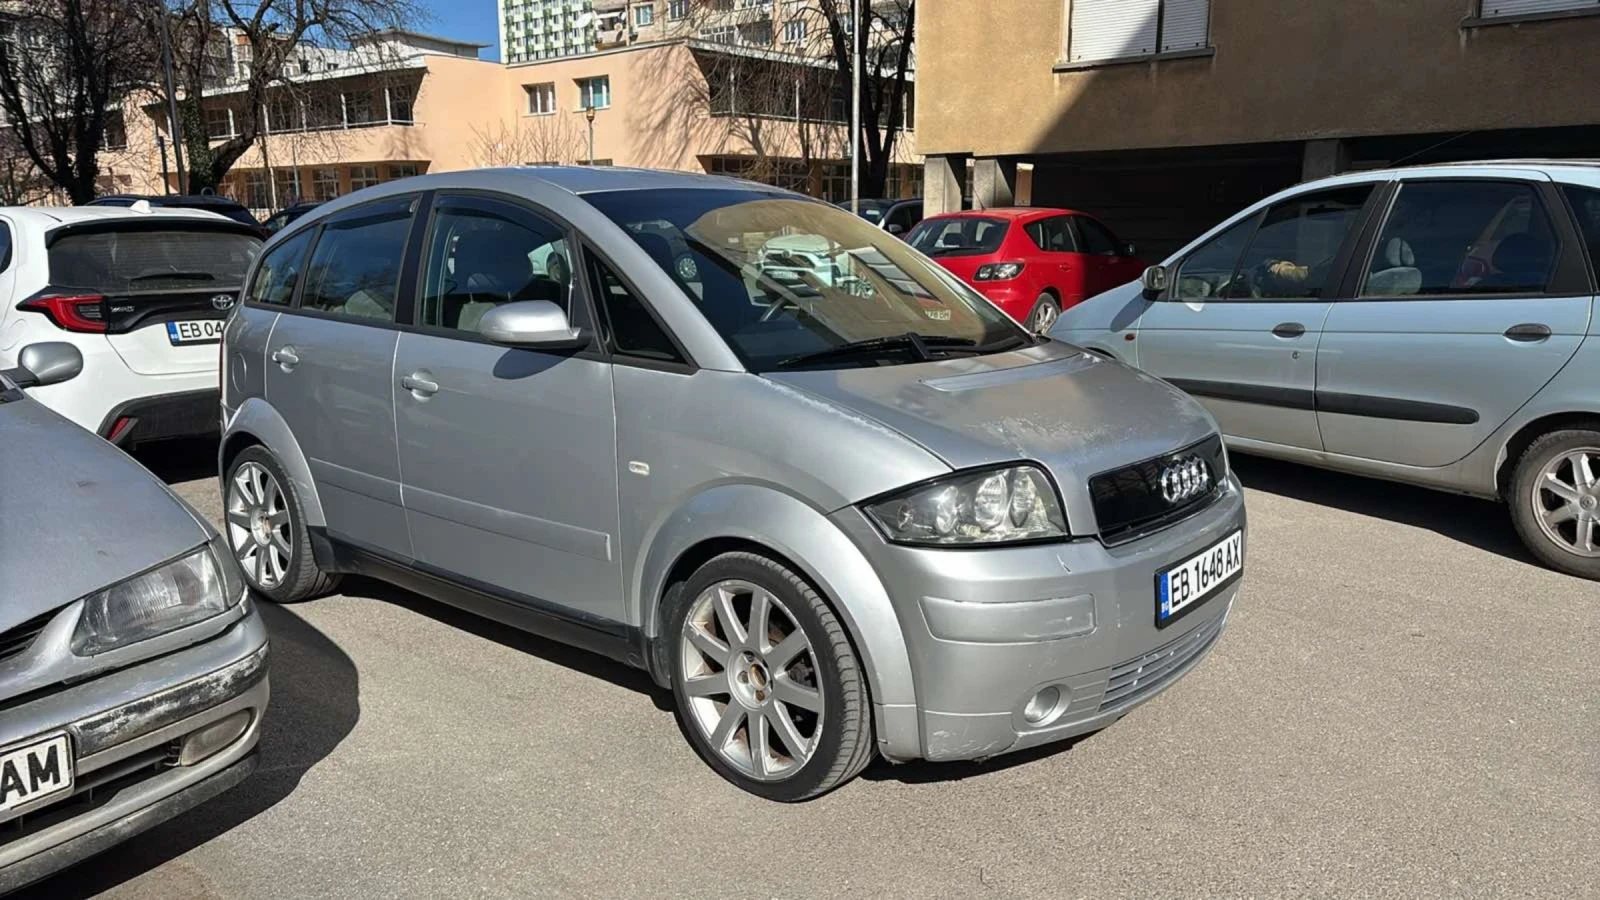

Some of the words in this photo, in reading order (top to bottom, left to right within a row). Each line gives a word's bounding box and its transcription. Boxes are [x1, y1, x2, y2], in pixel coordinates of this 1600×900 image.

[179, 322, 202, 338] EB
[1225, 535, 1240, 574] AX
[0, 744, 61, 805] AM
